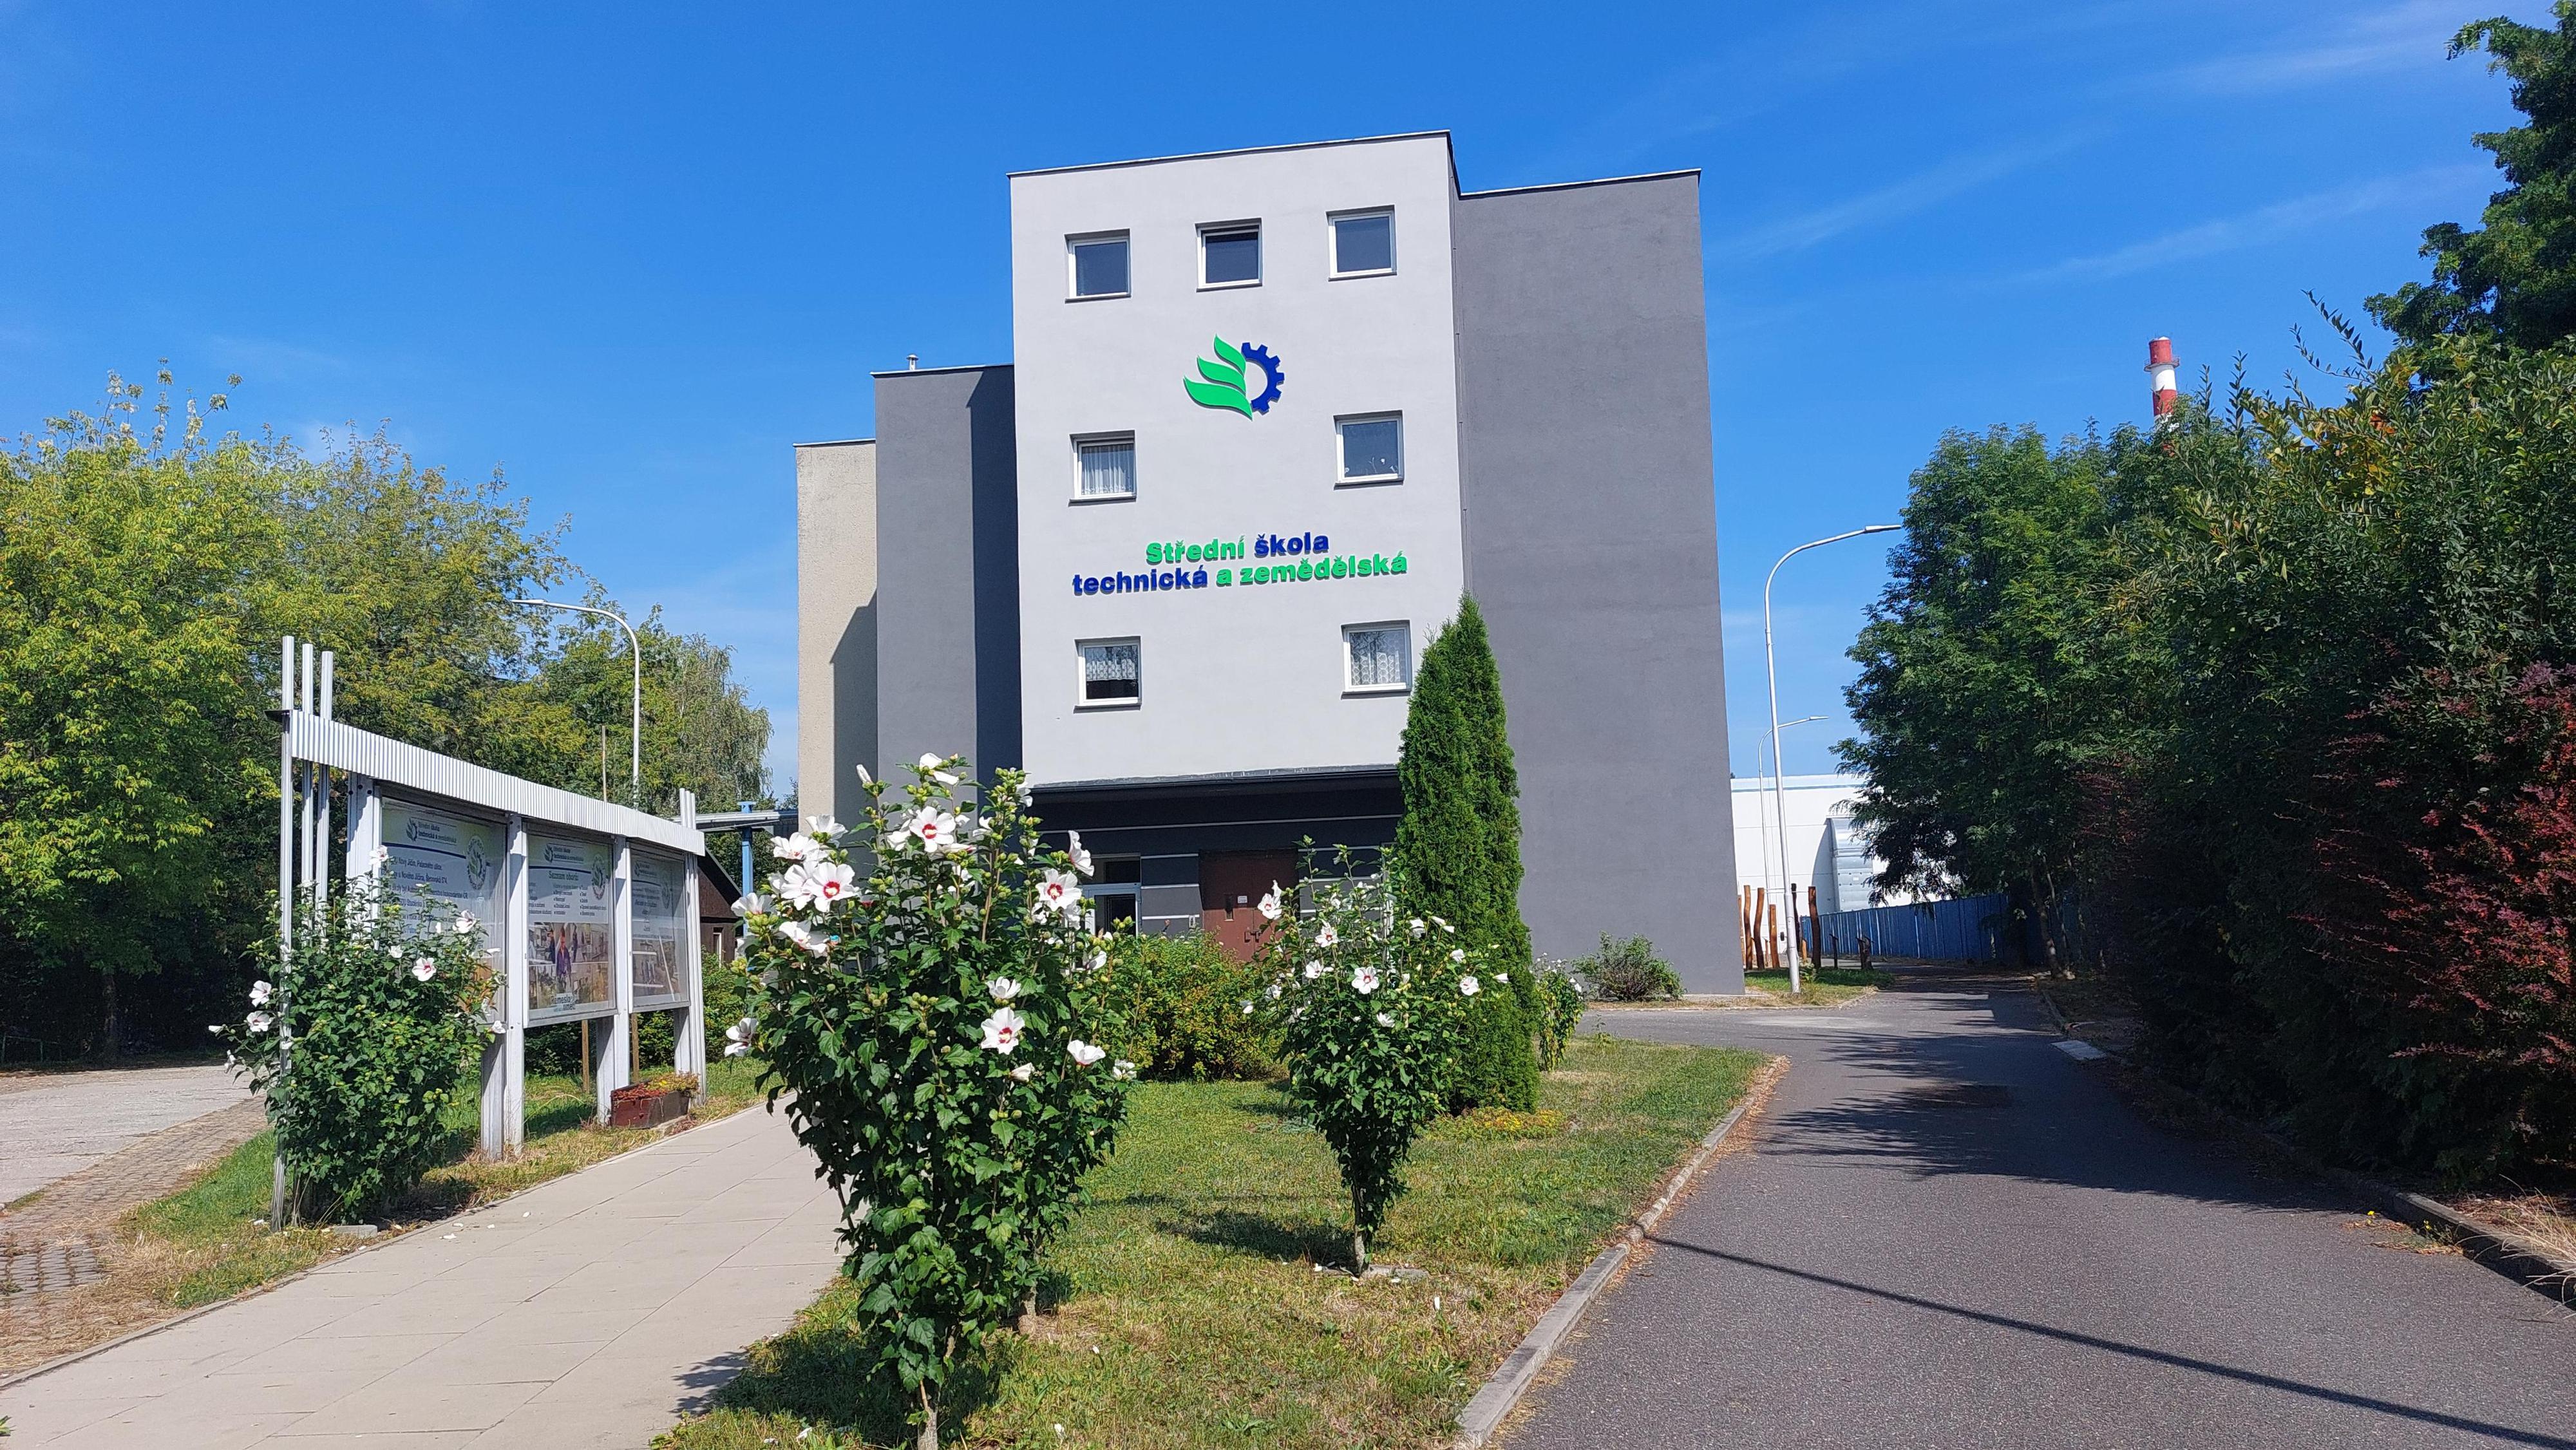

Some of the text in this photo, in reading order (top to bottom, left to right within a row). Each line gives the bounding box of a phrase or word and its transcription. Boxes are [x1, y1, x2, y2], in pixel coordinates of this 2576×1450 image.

[1146, 532, 1330, 565] Střední škola
[1072, 550, 1408, 596] technická a zemědělská
